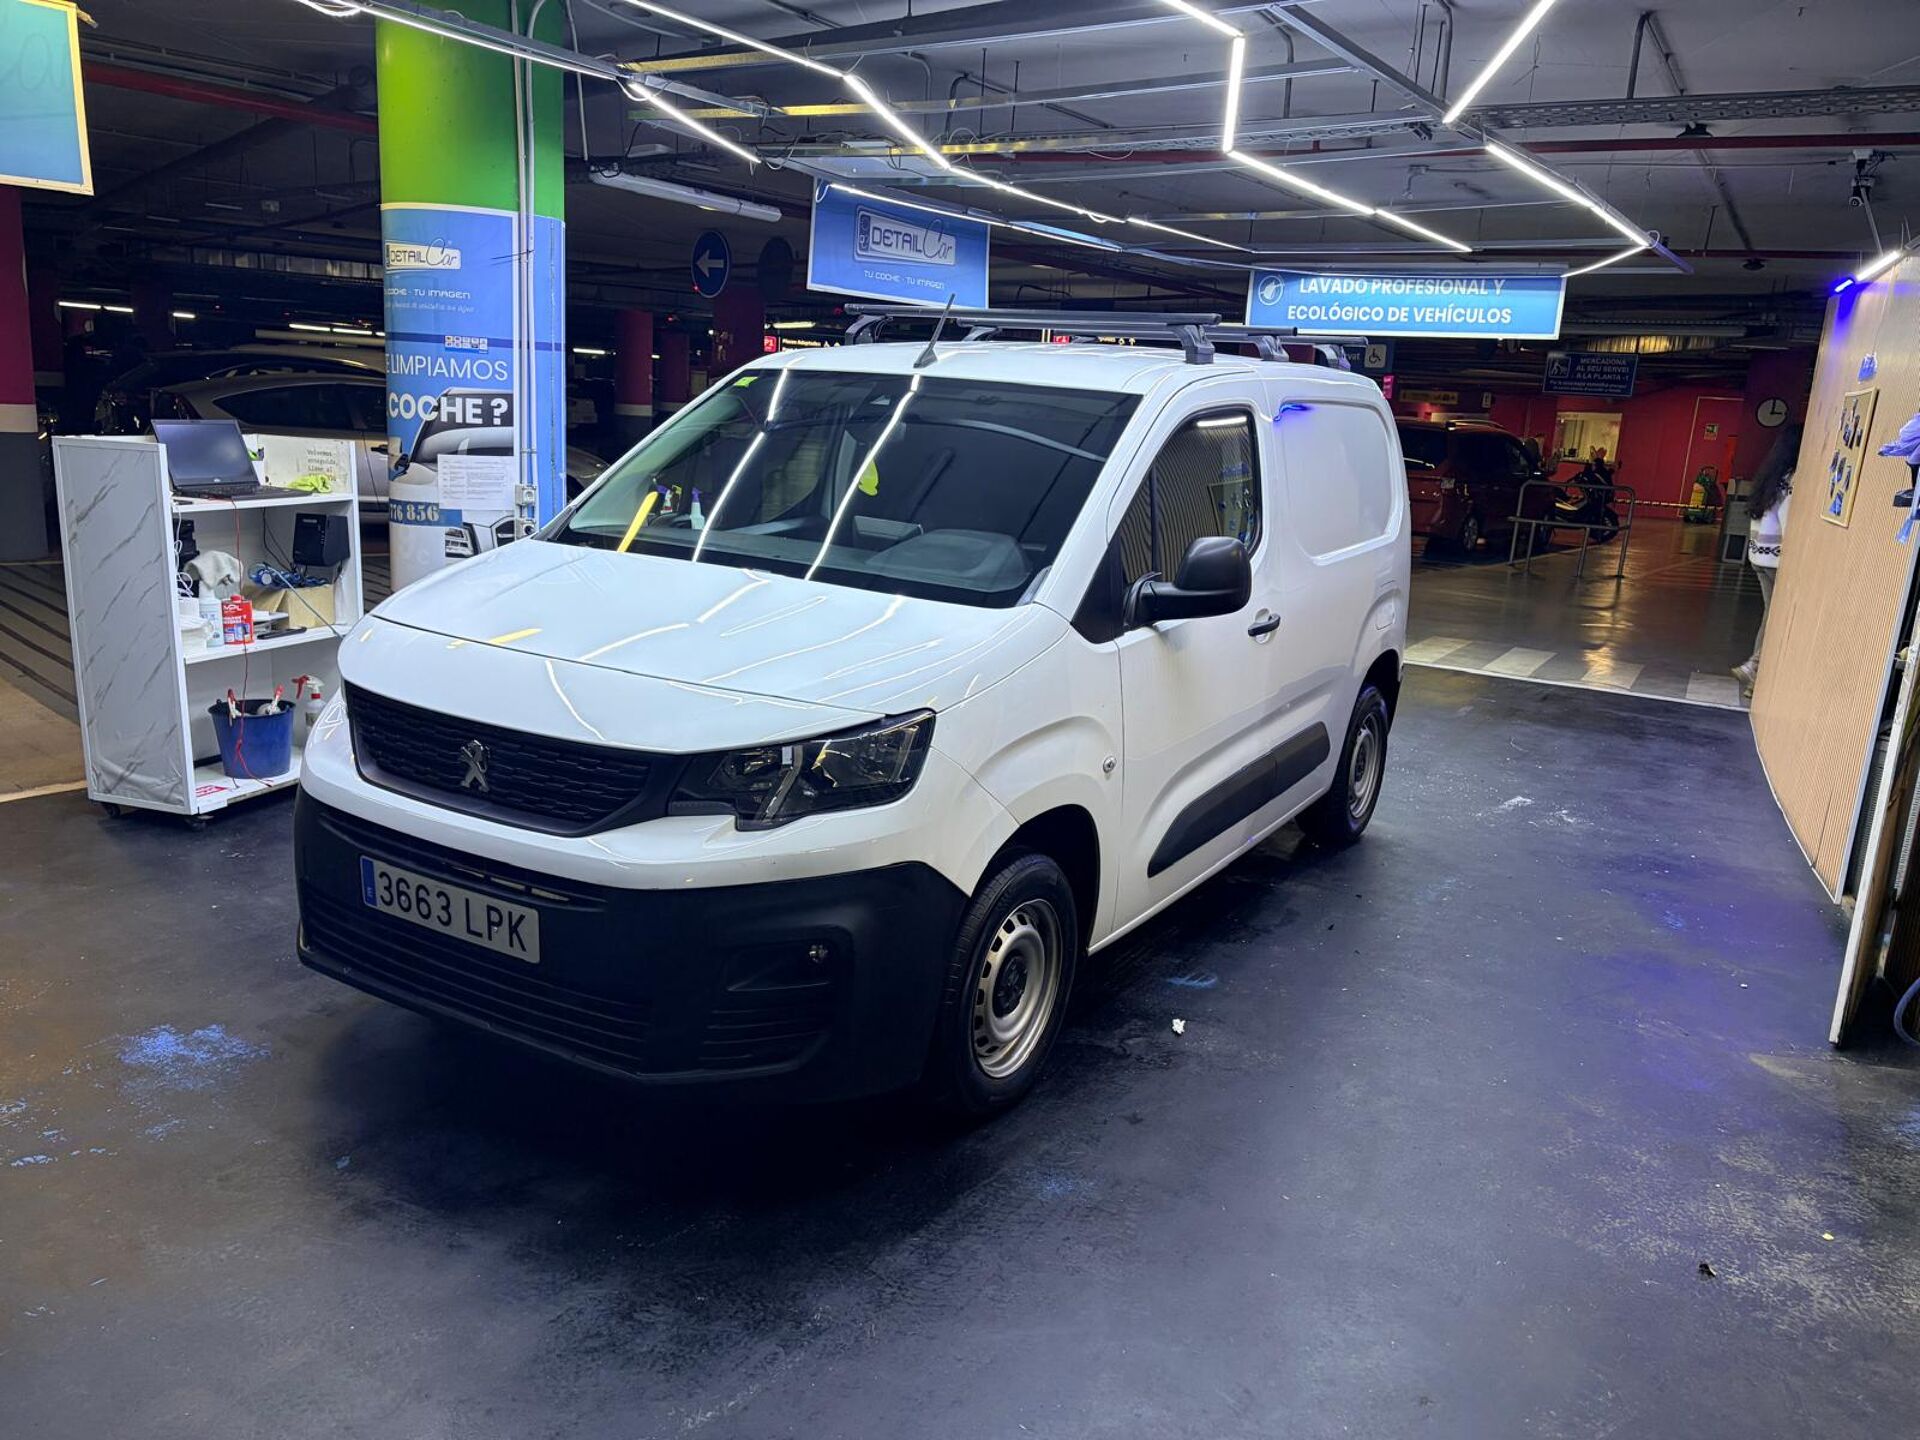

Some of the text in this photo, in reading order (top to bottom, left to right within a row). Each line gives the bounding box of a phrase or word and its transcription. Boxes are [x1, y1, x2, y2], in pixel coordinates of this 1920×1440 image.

[872, 226, 923, 253] DETAIL
[1299, 277, 1506, 296] LAVADO PROFESIONAL Y
[1287, 301, 1513, 324] ECOLÓGICO DE VEHÍCULOS
[391, 353, 508, 381] LIMPIAMOS
[406, 503, 440, 522] 856
[378, 871, 527, 953] 3663 LPK
